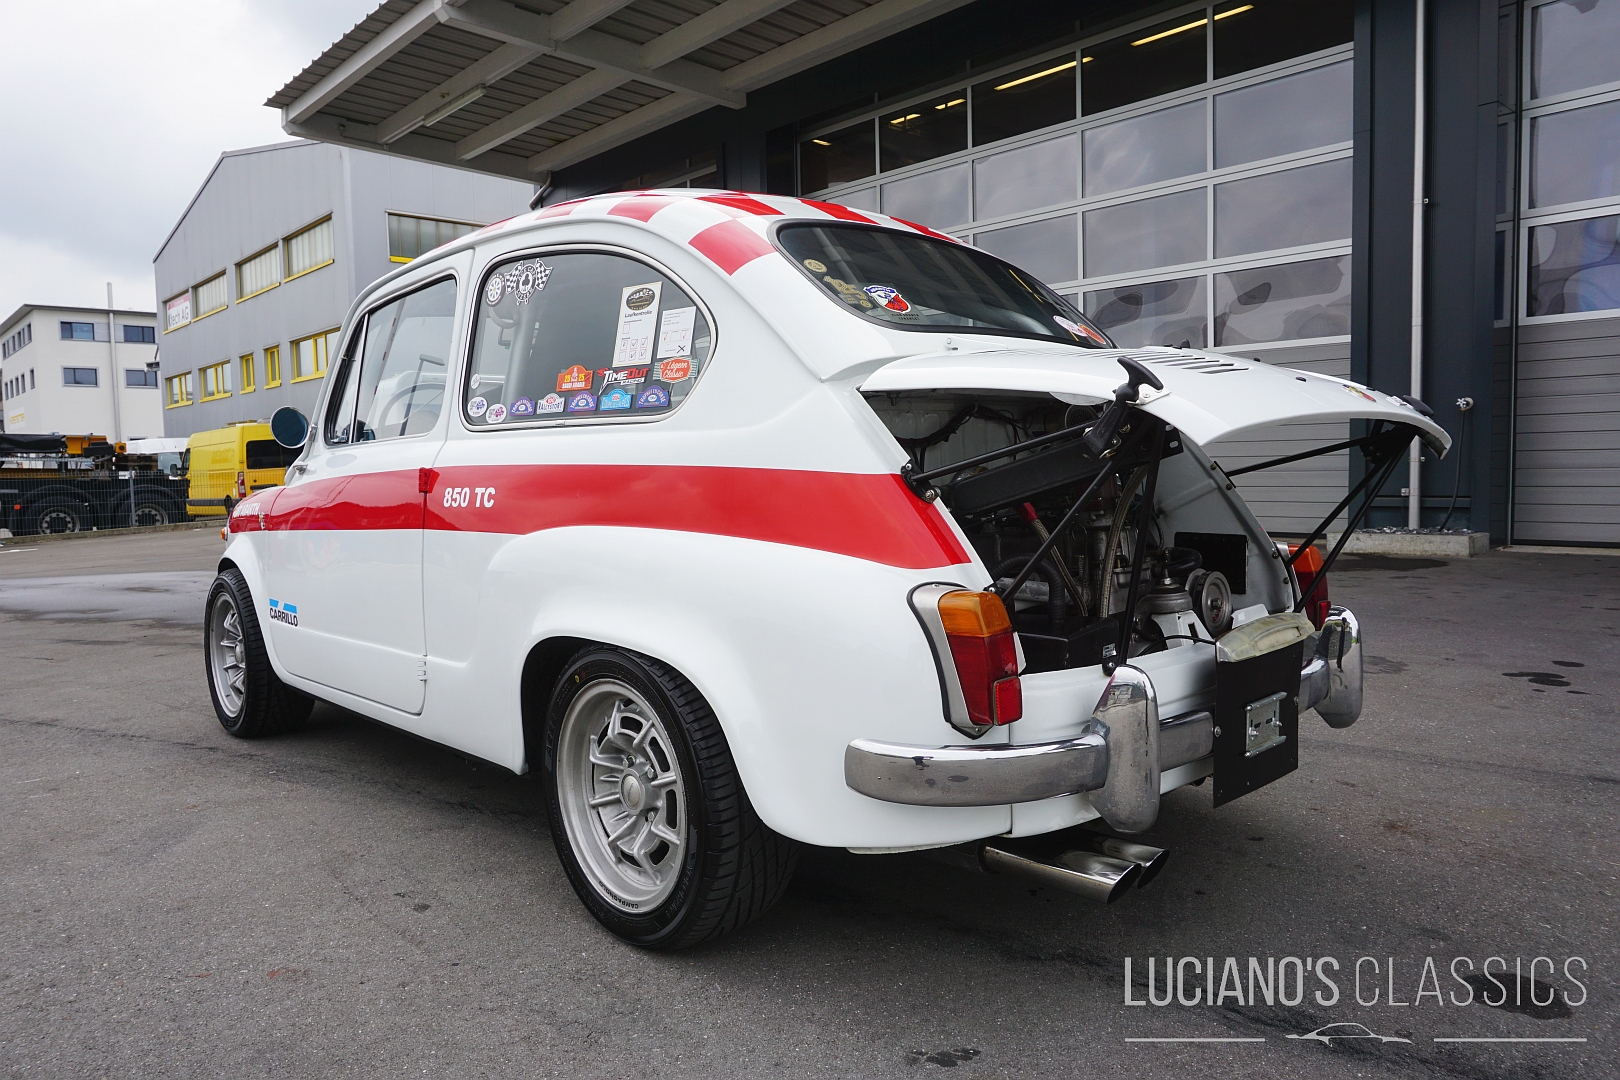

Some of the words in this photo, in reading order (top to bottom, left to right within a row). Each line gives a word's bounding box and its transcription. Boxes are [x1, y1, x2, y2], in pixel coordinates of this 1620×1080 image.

[181, 306, 189, 321] AG
[443, 487, 470, 508] 850
[474, 487, 496, 508] TC
[269, 607, 299, 627] CARRILLO
[598, 880, 639, 910] CAMPAGNOLO
